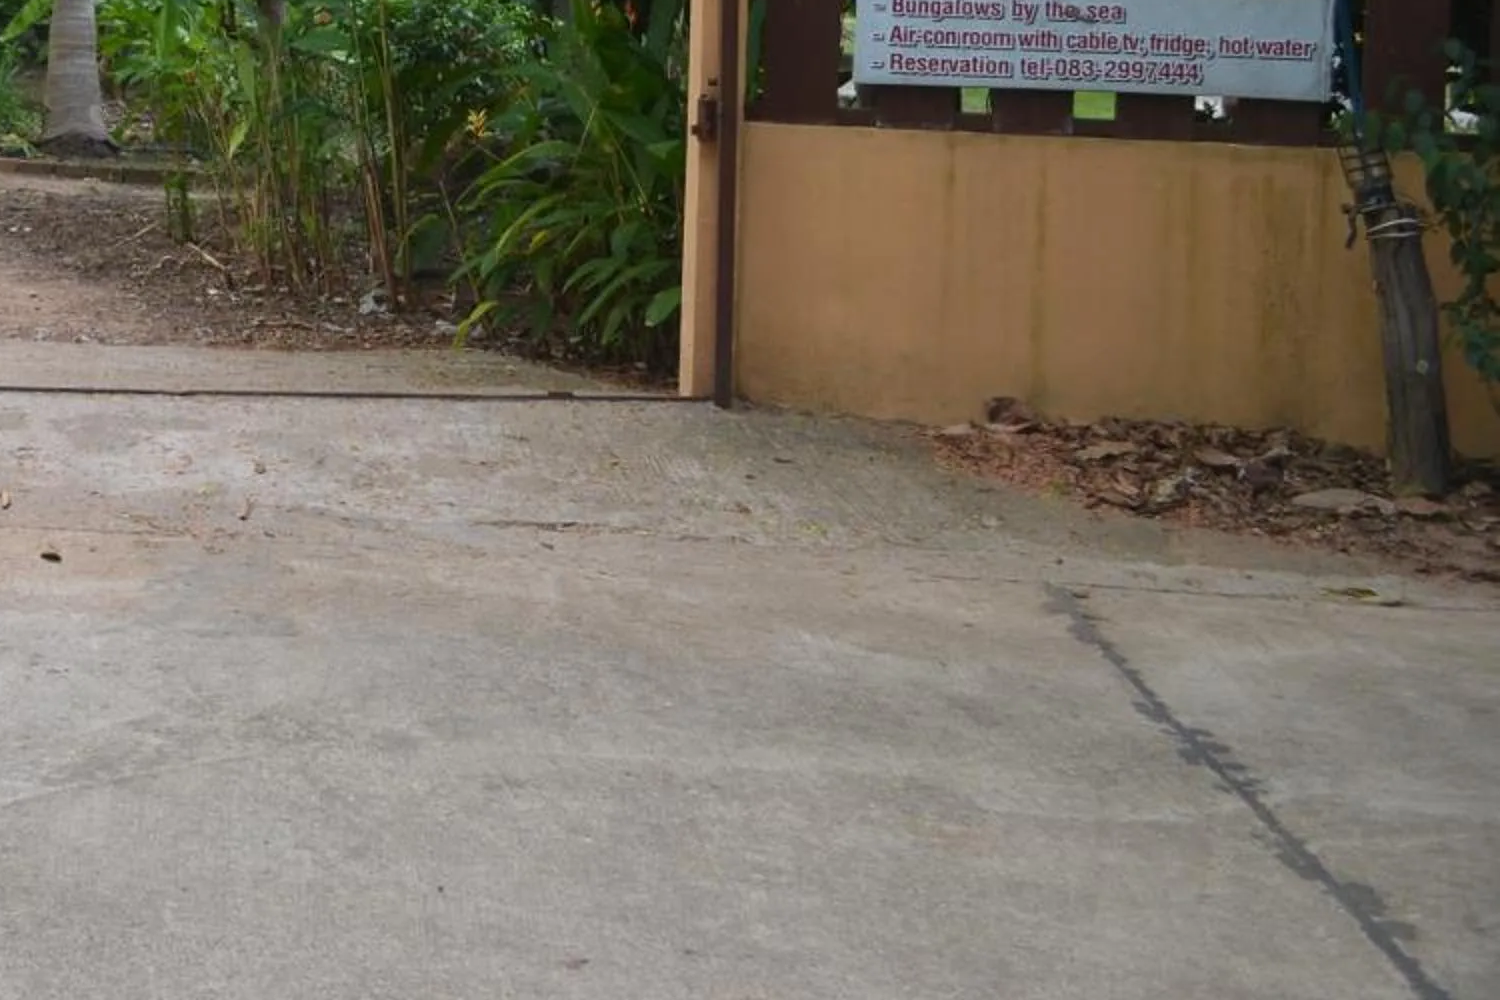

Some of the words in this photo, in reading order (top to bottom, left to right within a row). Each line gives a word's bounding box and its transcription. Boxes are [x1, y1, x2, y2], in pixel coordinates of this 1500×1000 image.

[1012, 0, 1039, 23] by
[1046, 0, 1079, 20] the
[1087, 3, 1125, 21] sea
[889, 26, 957, 46] Air-con
[961, 30, 1013, 48] room
[1018, 29, 1060, 50] with
[1066, 32, 1119, 51] cable
[1219, 35, 1251, 56] hot
[1257, 39, 1313, 58] water
[889, 54, 1012, 76] Reservation
